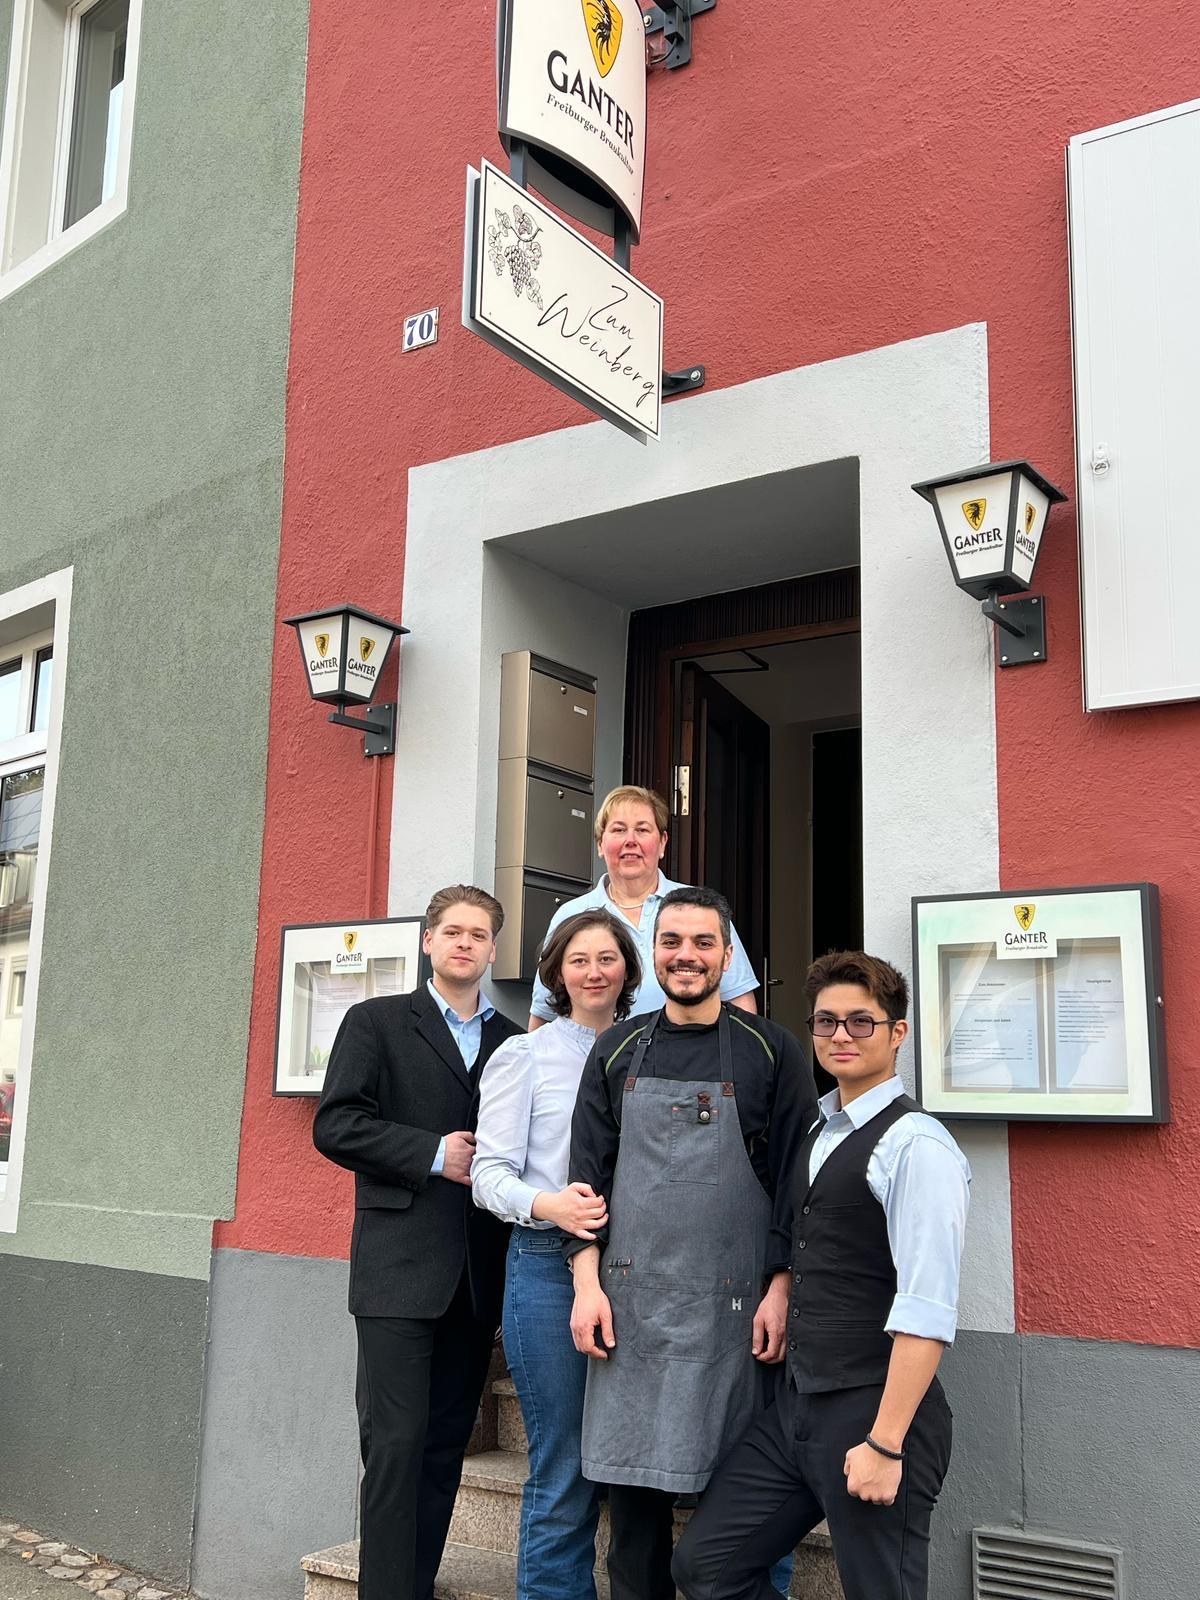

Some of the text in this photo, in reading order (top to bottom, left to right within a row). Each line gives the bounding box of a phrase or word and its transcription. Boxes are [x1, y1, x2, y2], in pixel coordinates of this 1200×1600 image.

[546, 93, 599, 134] Freiburger
[547, 49, 634, 160] GANTER
[588, 285, 635, 340] Zum
[406, 313, 433, 346] 70
[537, 292, 656, 408] Weinberg
[954, 527, 1003, 550] GANTER
[1015, 529, 1036, 557] GANTER
[310, 657, 339, 672] GANTER
[347, 658, 376, 677] GANTER
[1004, 931, 1048, 945] GANTER
[336, 952, 363, 963] GANTER
